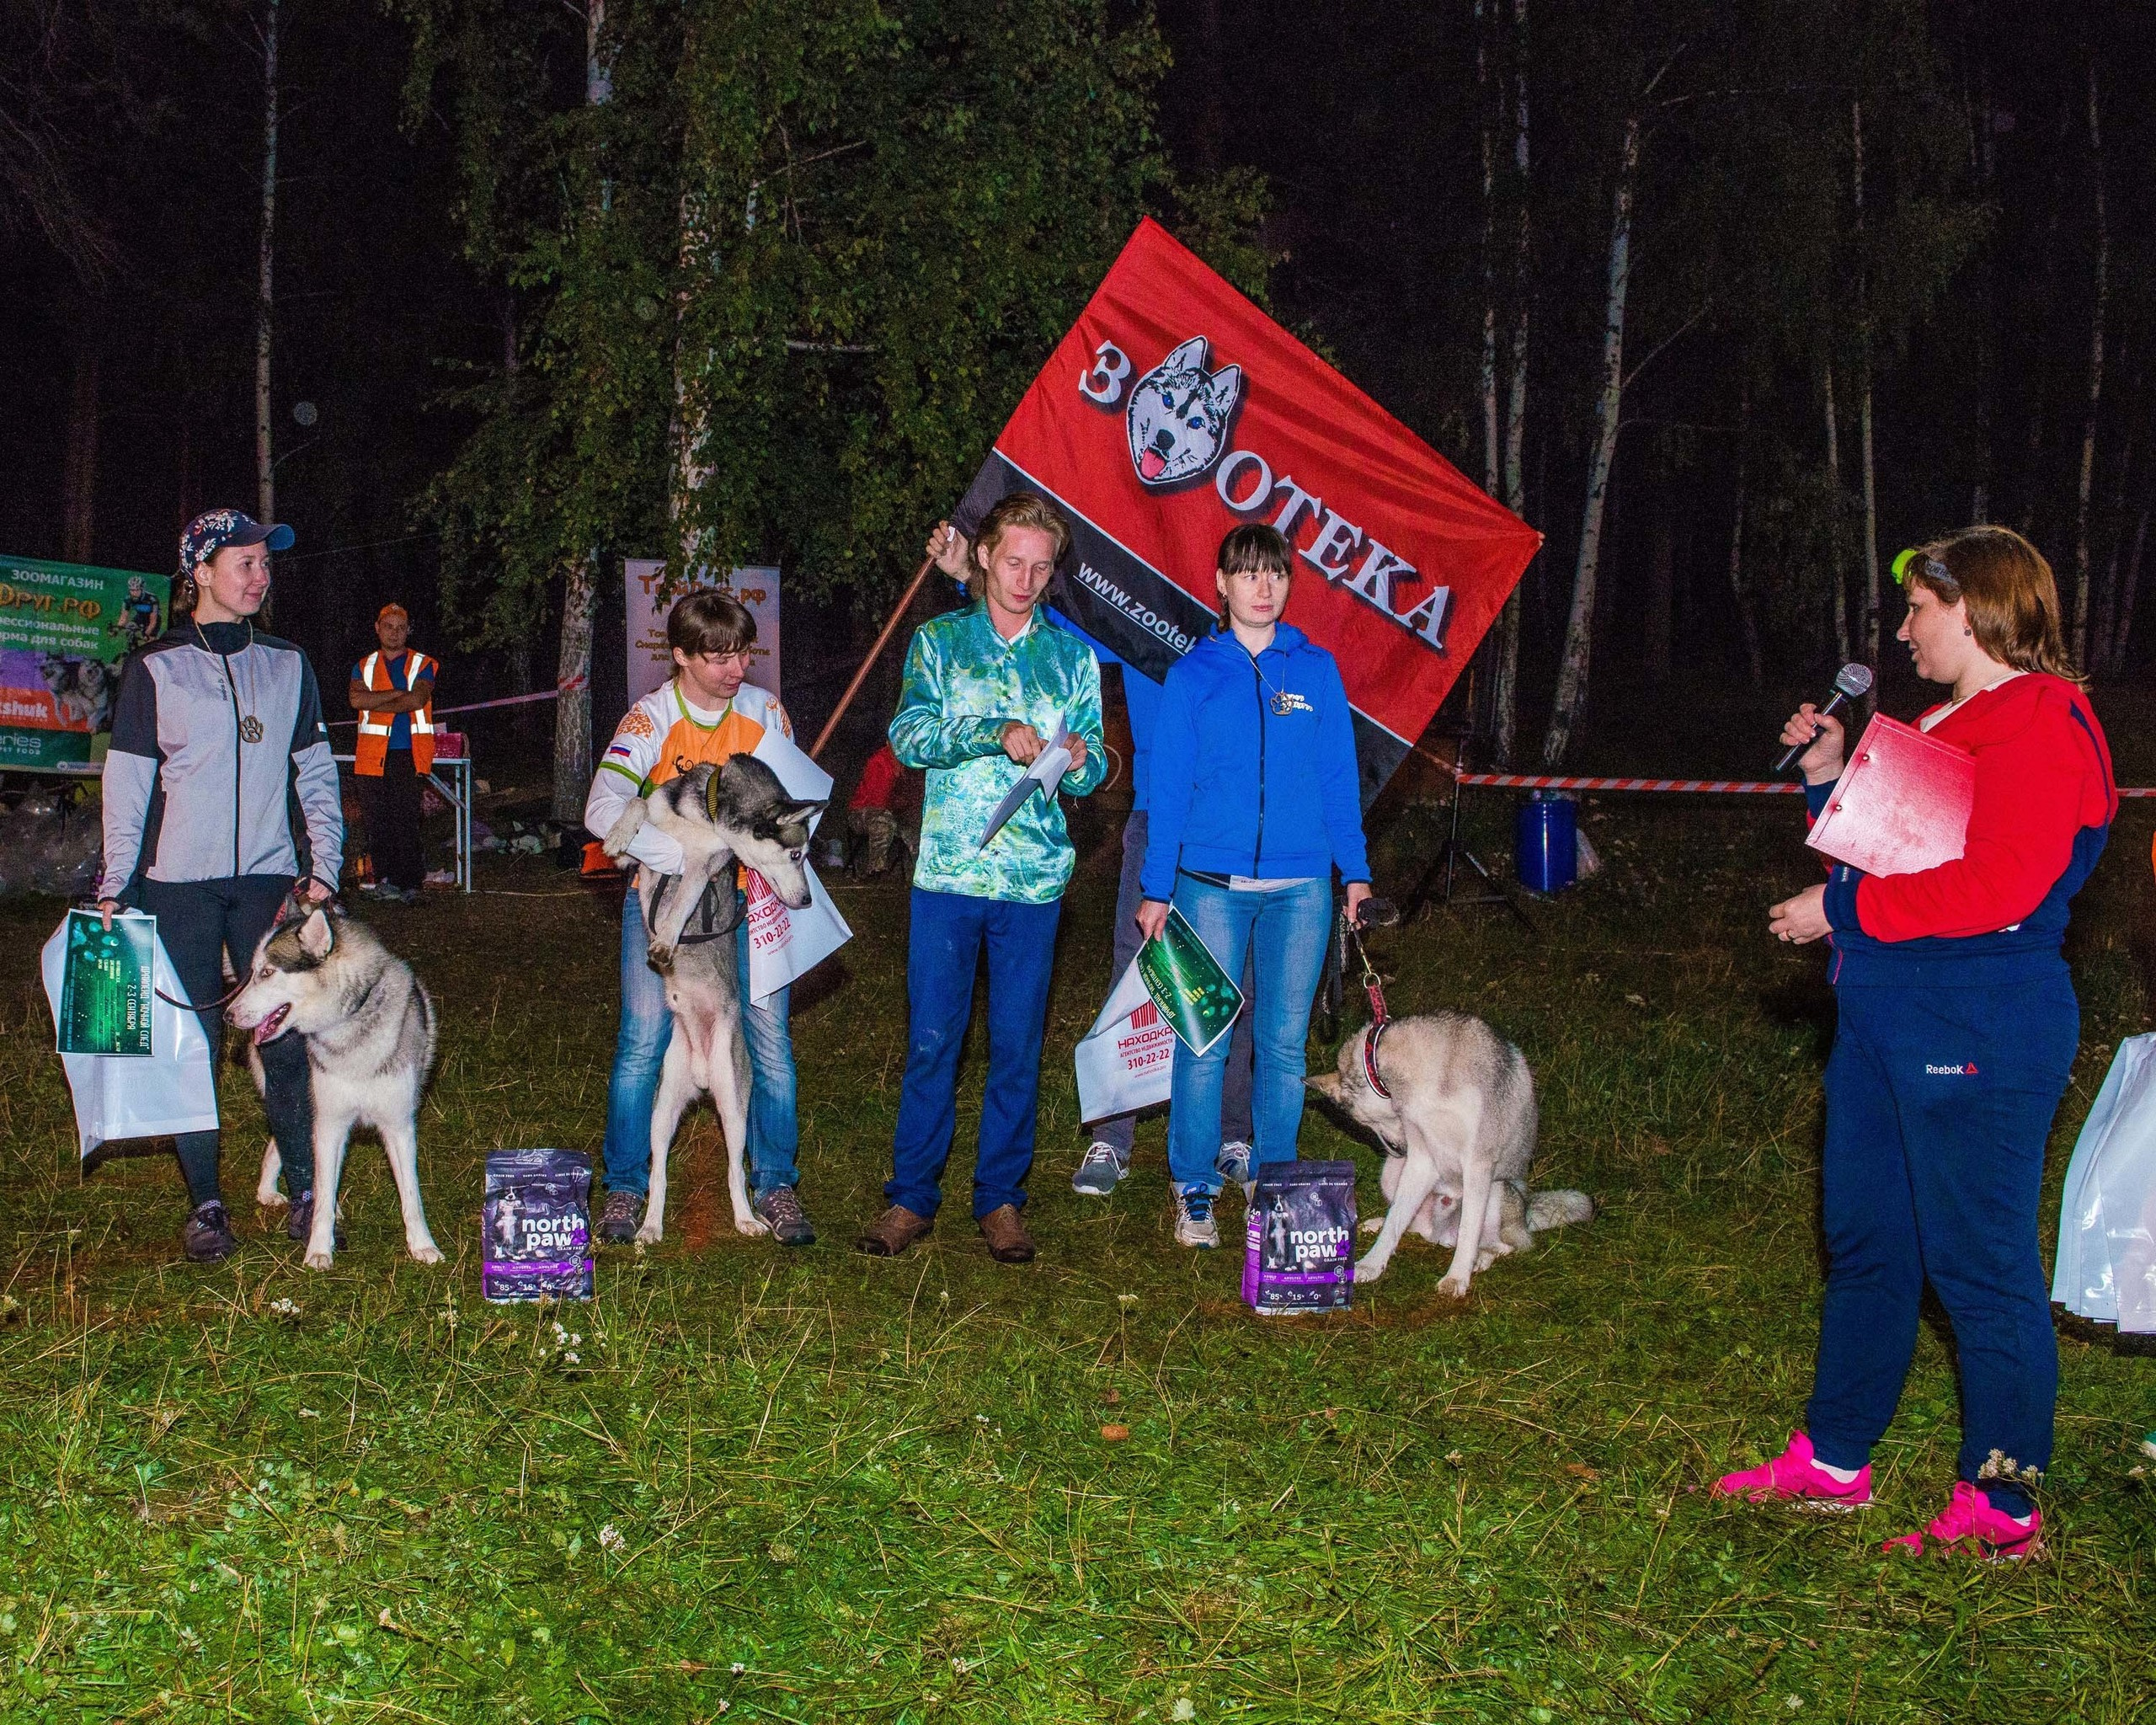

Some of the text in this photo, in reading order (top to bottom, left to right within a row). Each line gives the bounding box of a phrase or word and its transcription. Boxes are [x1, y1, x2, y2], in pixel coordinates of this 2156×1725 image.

[11, 569, 104, 590] ЗООМАГАЗИН
[60, 638, 99, 649] собак
[754, 917, 791, 949] 310-22-22
[126, 984, 136, 1030] 2-3 СЕНТЯБРЯ
[1118, 1027, 1172, 1049] НАХОДКА
[1127, 1049, 1170, 1071] 310-22-22
[1925, 1065, 1964, 1075] Reebok
[522, 1214, 584, 1233] north
[526, 1233, 574, 1252] paw
[1290, 1226, 1349, 1244] north
[1295, 1245, 1337, 1263] paw
